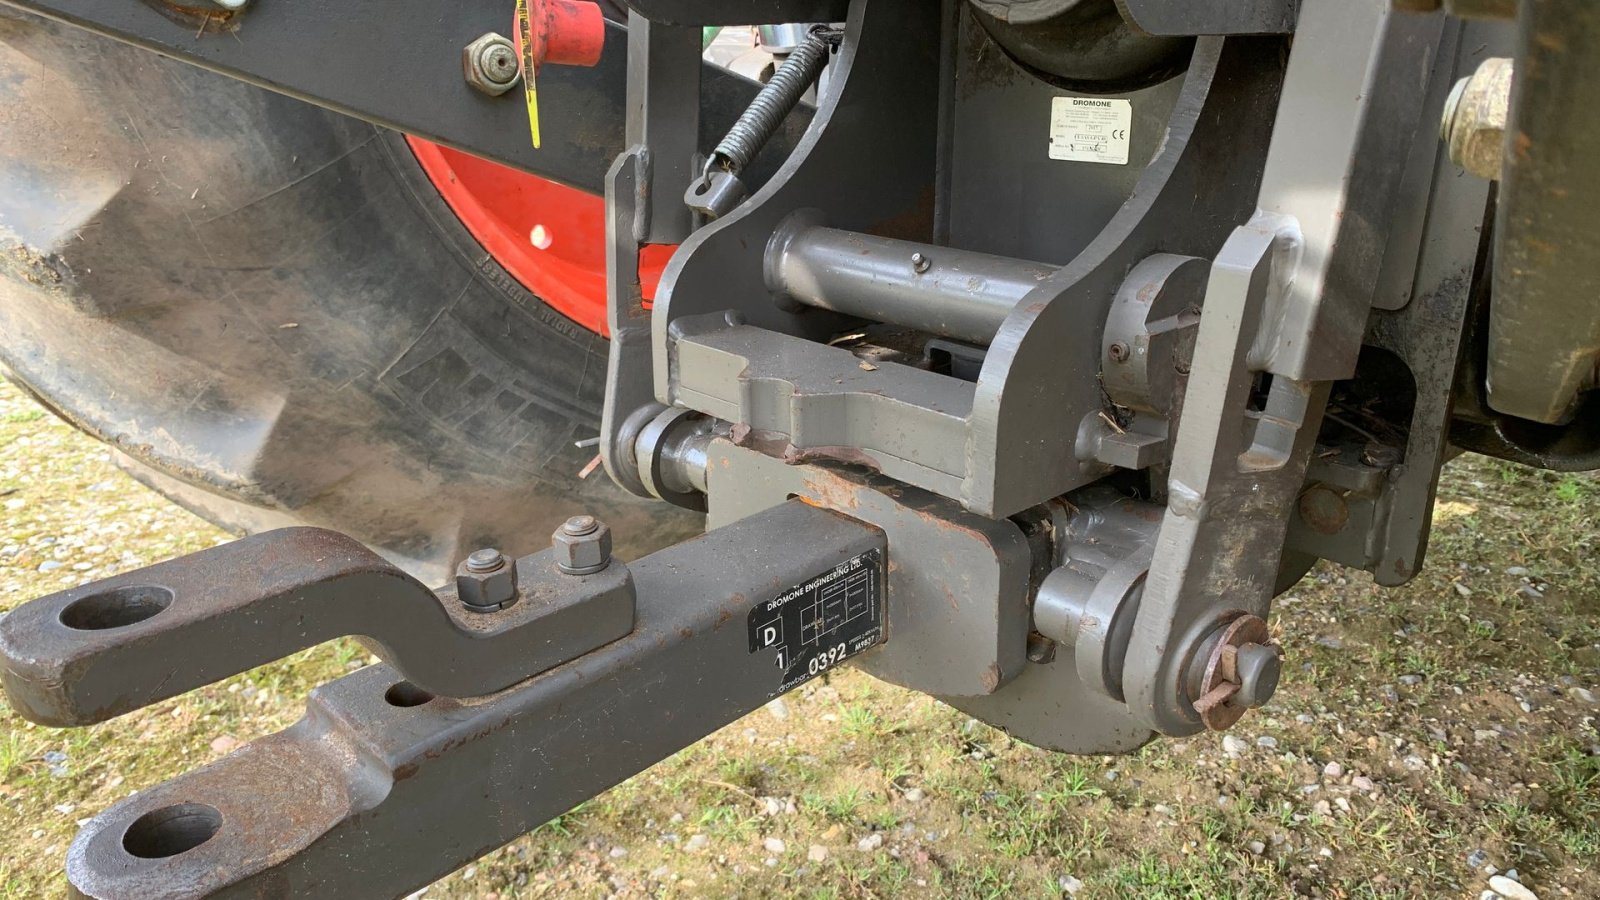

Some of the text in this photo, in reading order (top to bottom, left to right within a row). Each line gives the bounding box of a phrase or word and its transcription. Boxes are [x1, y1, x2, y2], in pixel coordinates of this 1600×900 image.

[476, 257, 580, 339] RADIAL TUBELESS
[767, 588, 804, 611] DROMONE
[805, 566, 849, 593] ENGINEERING
[764, 626, 777, 646] D
[808, 642, 847, 675] 0392
